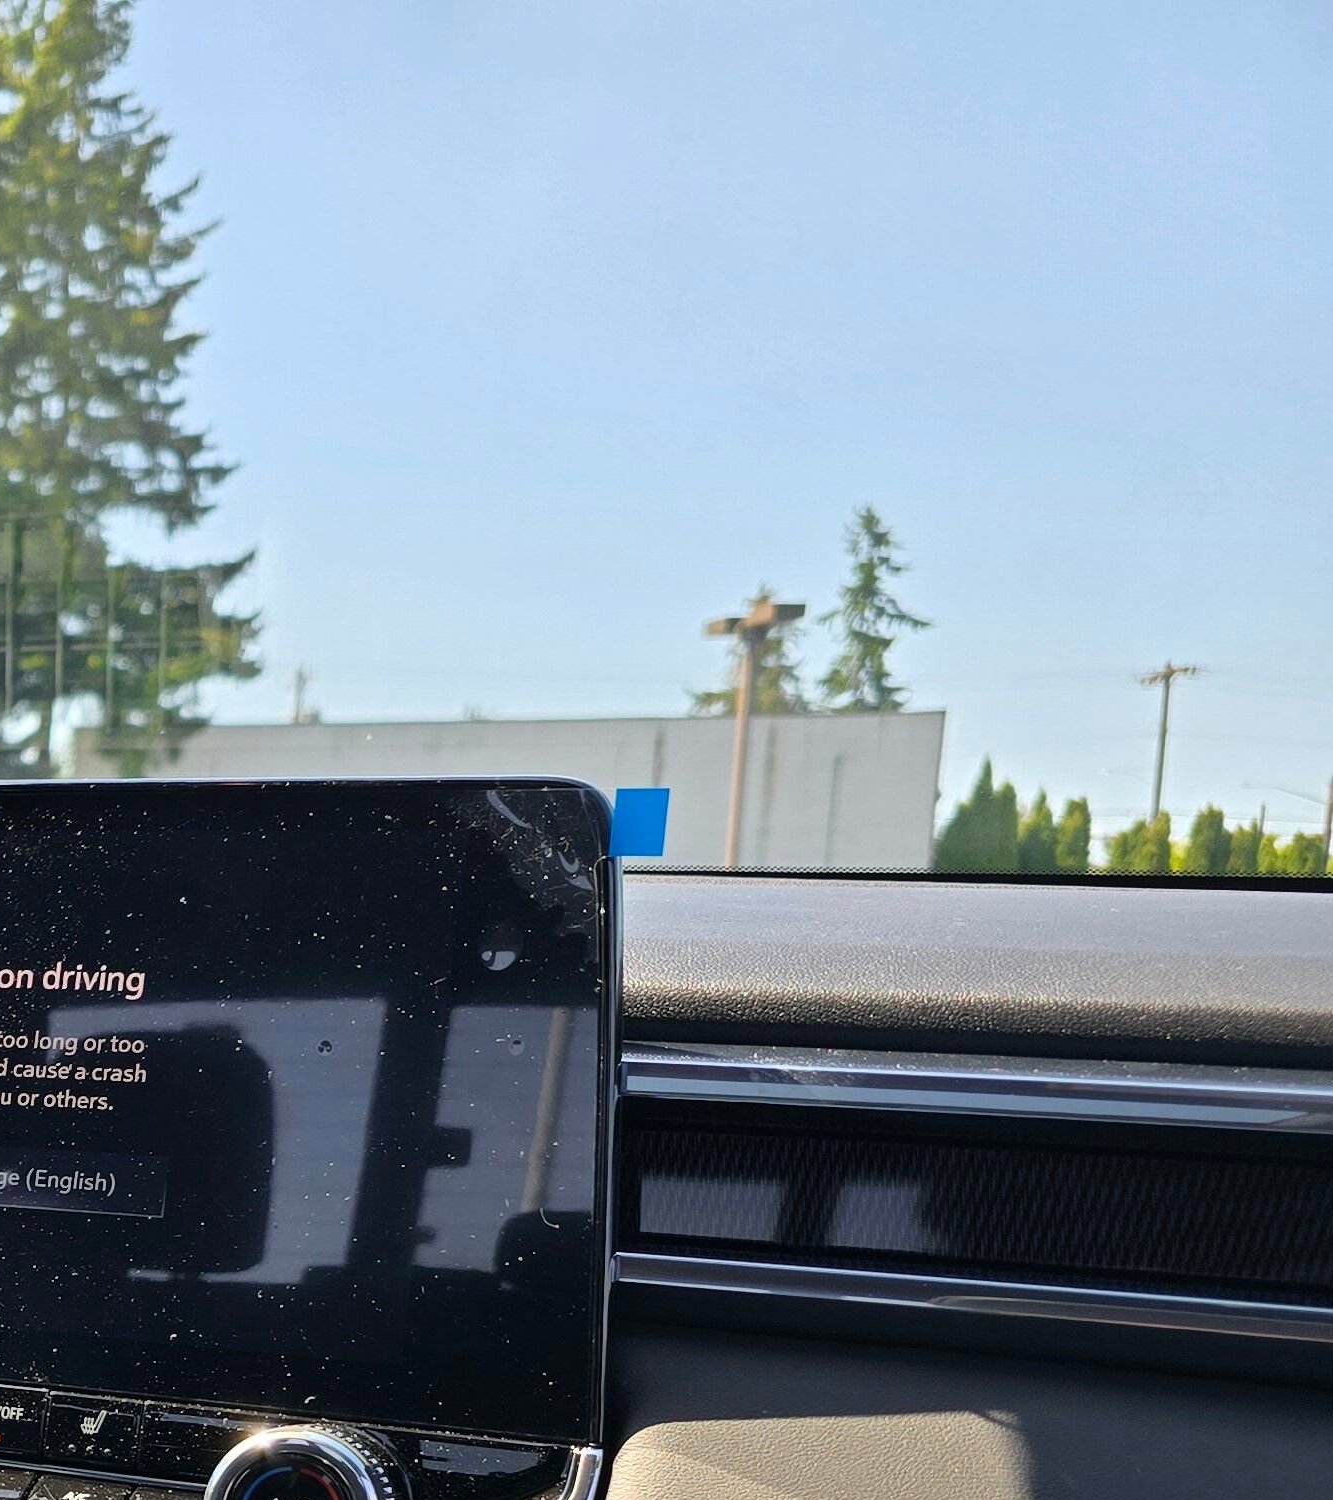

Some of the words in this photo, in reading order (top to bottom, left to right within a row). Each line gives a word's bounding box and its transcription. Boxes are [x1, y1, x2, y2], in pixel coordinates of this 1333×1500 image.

[42, 961, 146, 1000] driving
[33, 1030, 79, 1056] long
[83, 1037, 107, 1053] or
[110, 1035, 145, 1054] too
[13, 1064, 69, 1080] cause
[74, 1066, 87, 1081] a
[91, 1063, 147, 1083] crash
[17, 1091, 40, 1107] or
[43, 1089, 114, 1111] others.
[25, 1167, 117, 1196] (English)
